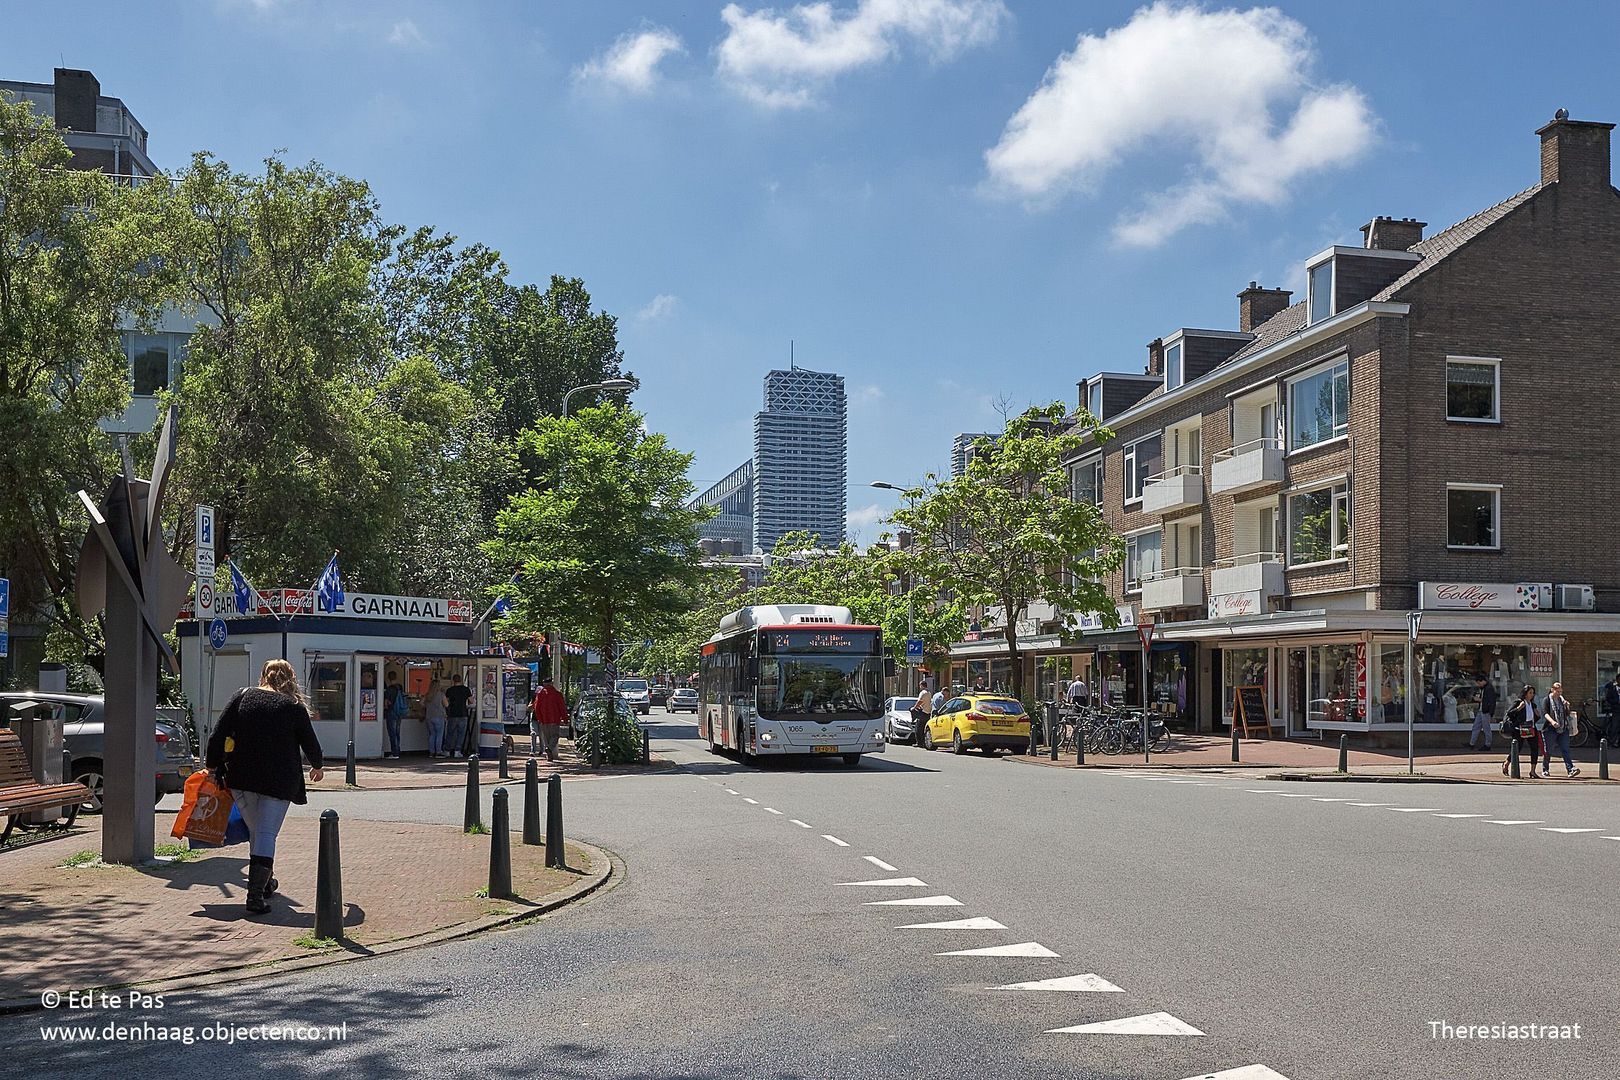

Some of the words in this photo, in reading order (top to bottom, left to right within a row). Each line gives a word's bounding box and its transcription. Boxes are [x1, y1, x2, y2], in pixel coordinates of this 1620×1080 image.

[202, 592, 210, 601] 30
[214, 596, 256, 614] GARNAL
[1224, 594, 1253, 615] College
[1435, 584, 1498, 608] College
[352, 596, 445, 619] GARNAAL
[776, 634, 790, 647] 24
[1357, 645, 1366, 715] SALE
[788, 725, 804, 733] 1065
